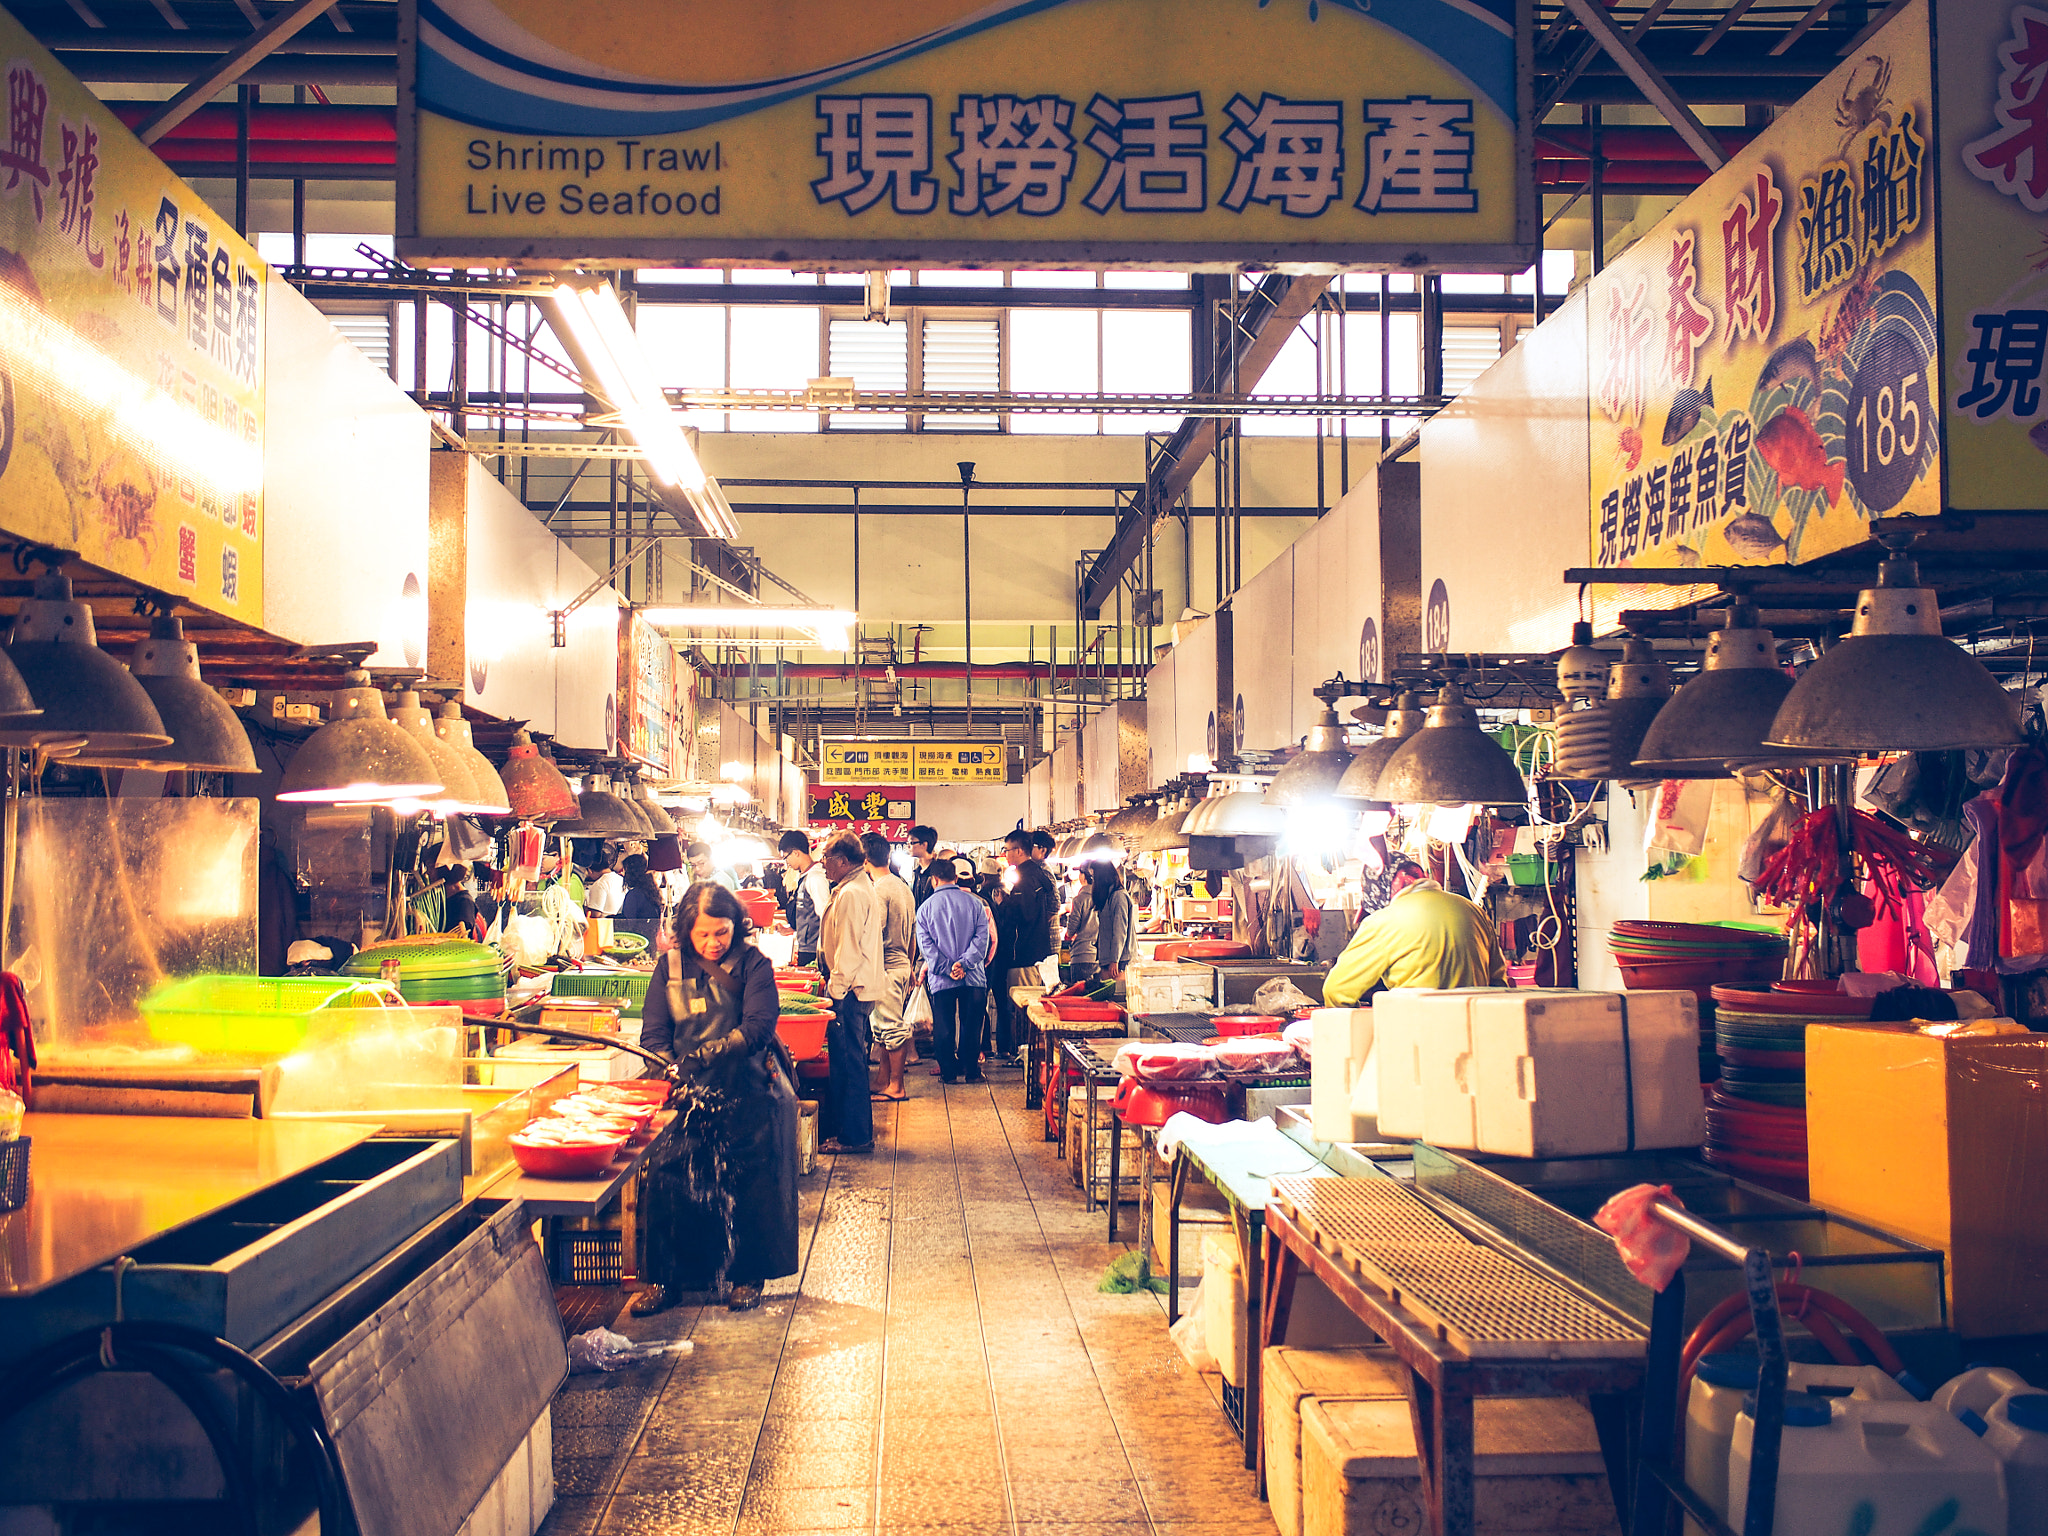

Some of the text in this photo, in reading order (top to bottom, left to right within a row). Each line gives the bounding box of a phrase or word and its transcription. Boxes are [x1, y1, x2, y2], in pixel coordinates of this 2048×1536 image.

[467, 139, 720, 178] Shrimp Trawl
[811, 90, 1478, 218] 現撈活海產
[467, 184, 720, 215] Live Seafood
[1800, 111, 1921, 297] 漁船
[154, 196, 258, 391] 各種魚類
[1602, 172, 1779, 419] 新春財
[1856, 372, 1922, 472] 185
[1598, 418, 1750, 568] 現撈海鮮魚貨
[1428, 600, 1447, 650] 184
[1361, 636, 1377, 679] 183
[855, 767, 880, 776] 門市部
[883, 767, 909, 776] 洗手間
[919, 767, 944, 776] 服務台
[952, 767, 968, 776] 電梯
[828, 790, 886, 821] 盛豐
